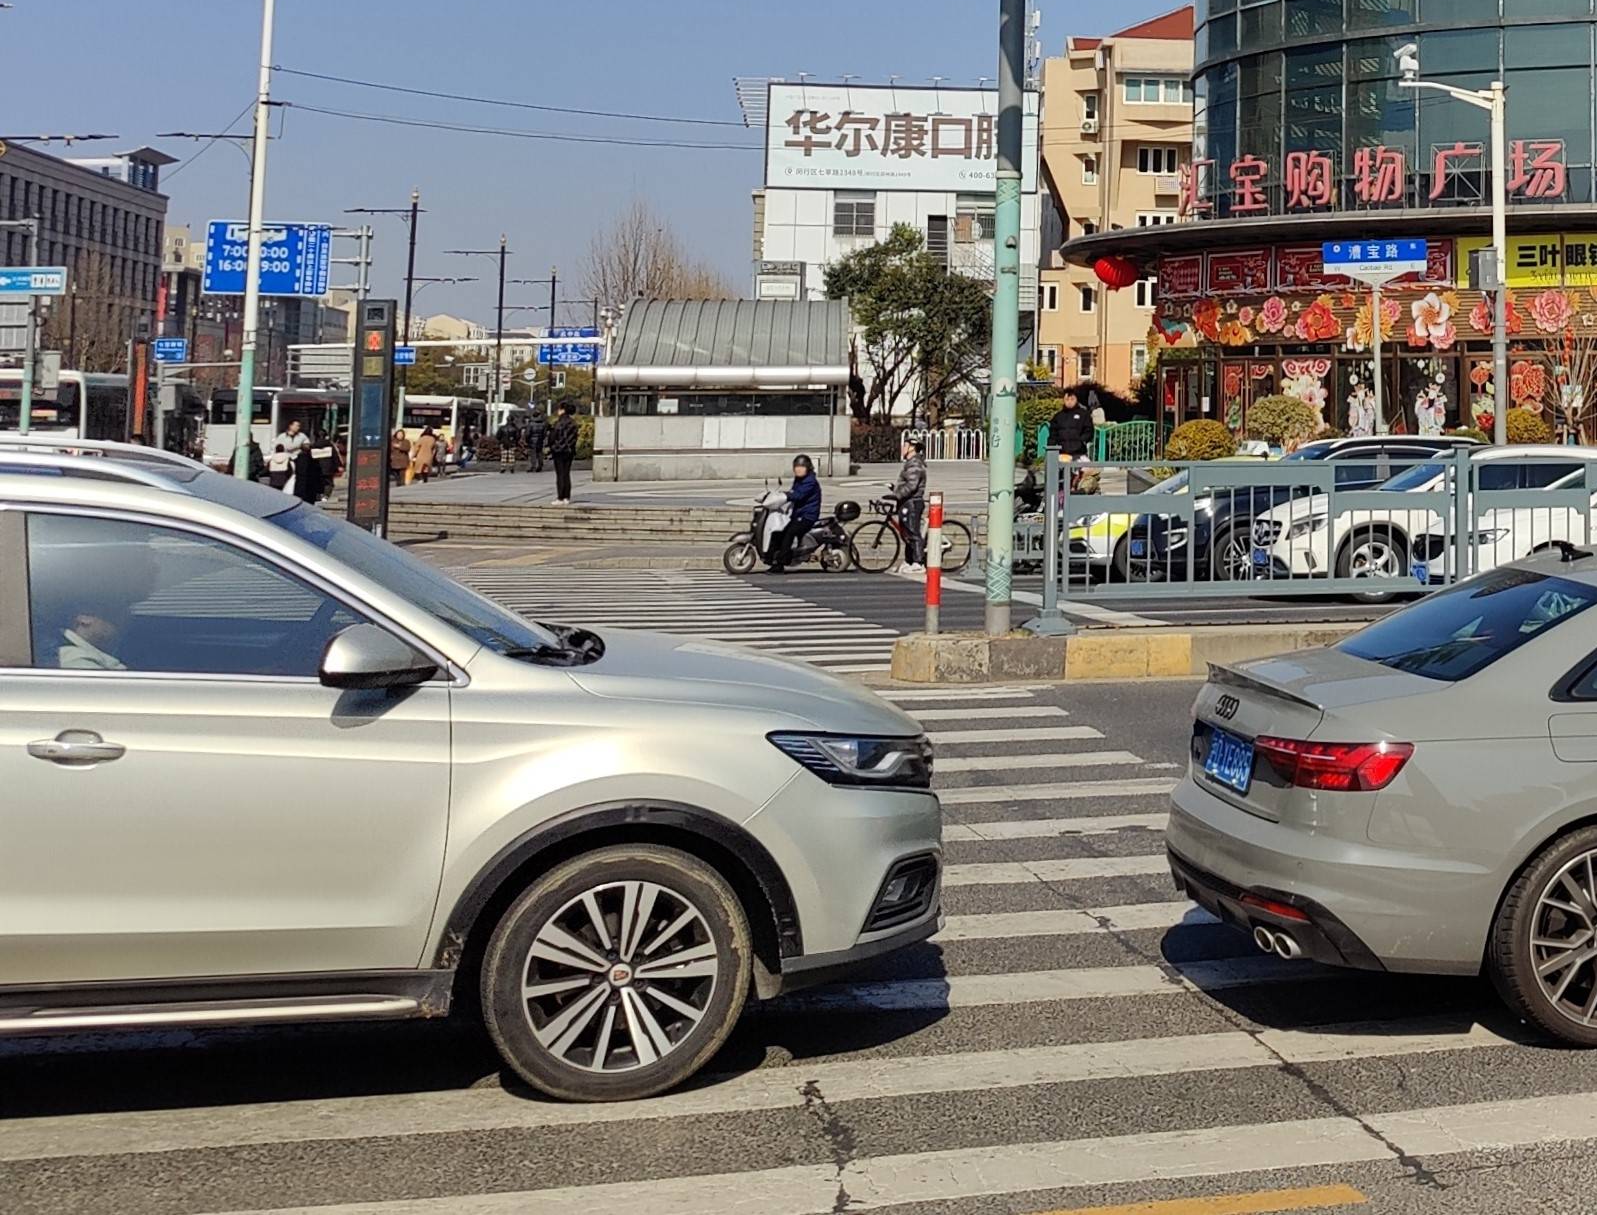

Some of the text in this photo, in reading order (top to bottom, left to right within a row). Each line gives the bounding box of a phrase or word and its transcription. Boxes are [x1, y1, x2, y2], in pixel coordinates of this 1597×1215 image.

[1179, 138, 1565, 216] 汇宝购物广场
